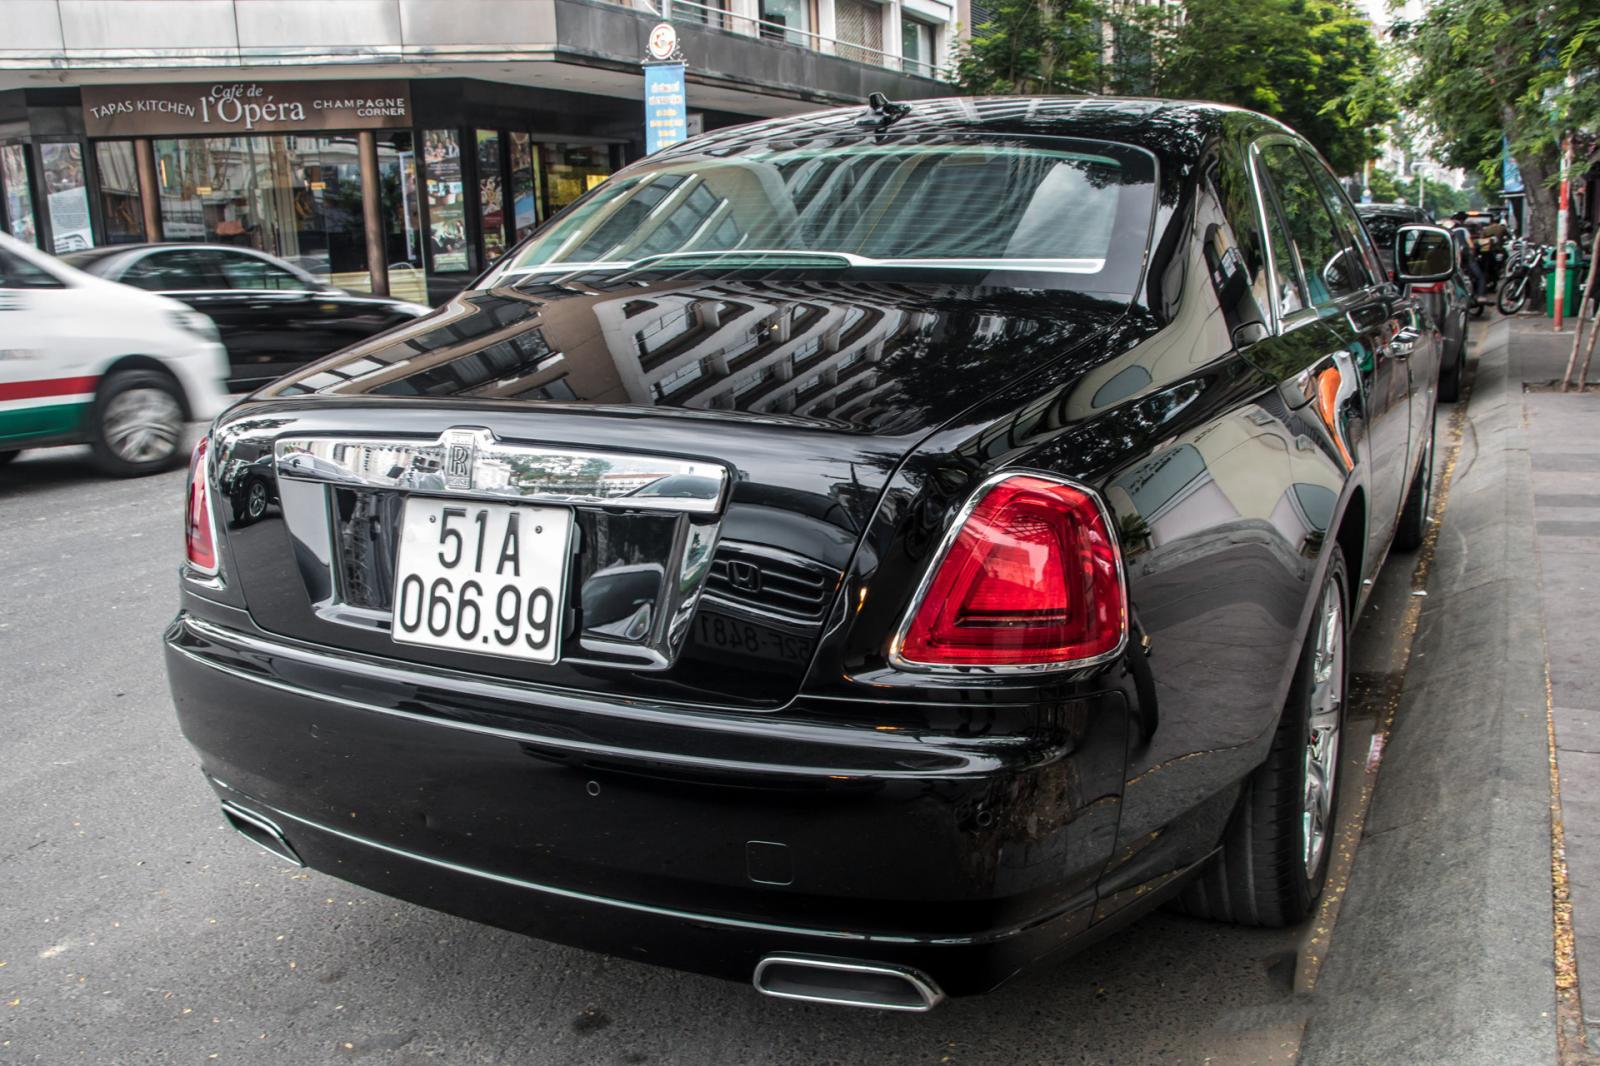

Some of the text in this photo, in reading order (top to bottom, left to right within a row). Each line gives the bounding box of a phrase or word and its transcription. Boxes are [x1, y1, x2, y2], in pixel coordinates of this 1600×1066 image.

[211, 84, 263, 104] Café de
[313, 98, 405, 109] CHAMPAGNE
[90, 100, 195, 119] TAPAS KITCHEN
[357, 107, 406, 117] CORNER
[438, 507, 521, 577] 51A
[400, 573, 554, 650] 066.99
